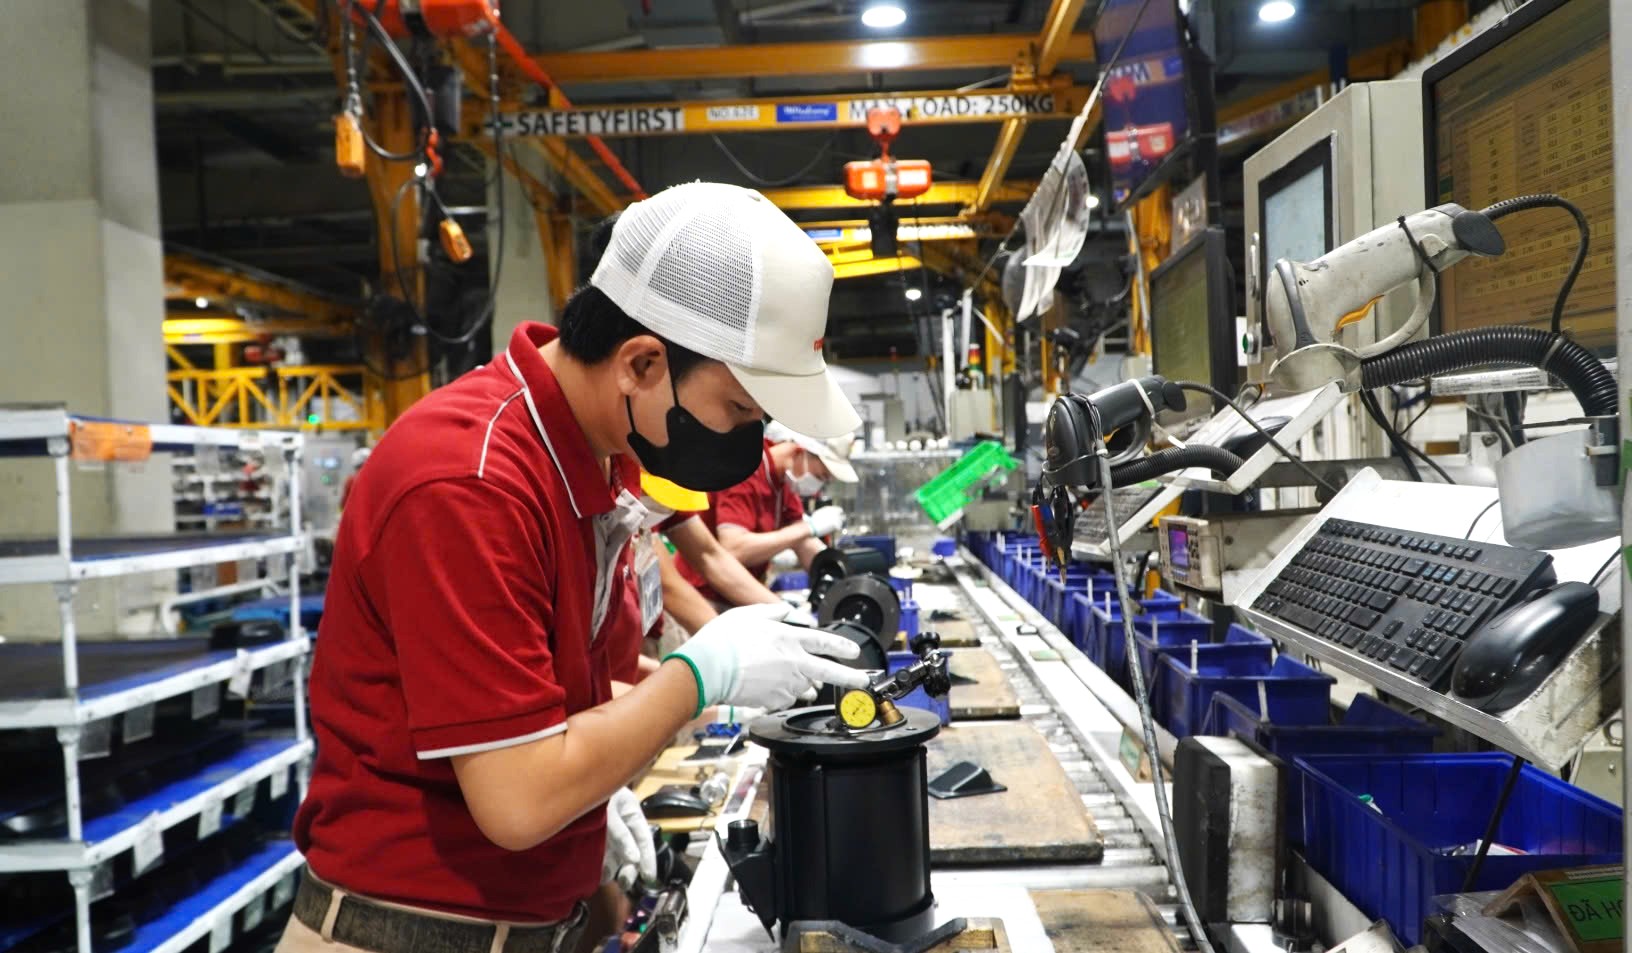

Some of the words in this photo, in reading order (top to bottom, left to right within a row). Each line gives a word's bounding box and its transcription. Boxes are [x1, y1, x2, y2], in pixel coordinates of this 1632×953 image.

[911, 96, 977, 118] OAD:
[985, 93, 1054, 114] 250KG
[516, 107, 682, 137] SAFETYFIRST
[1567, 899, 1602, 921] ĐÃ
